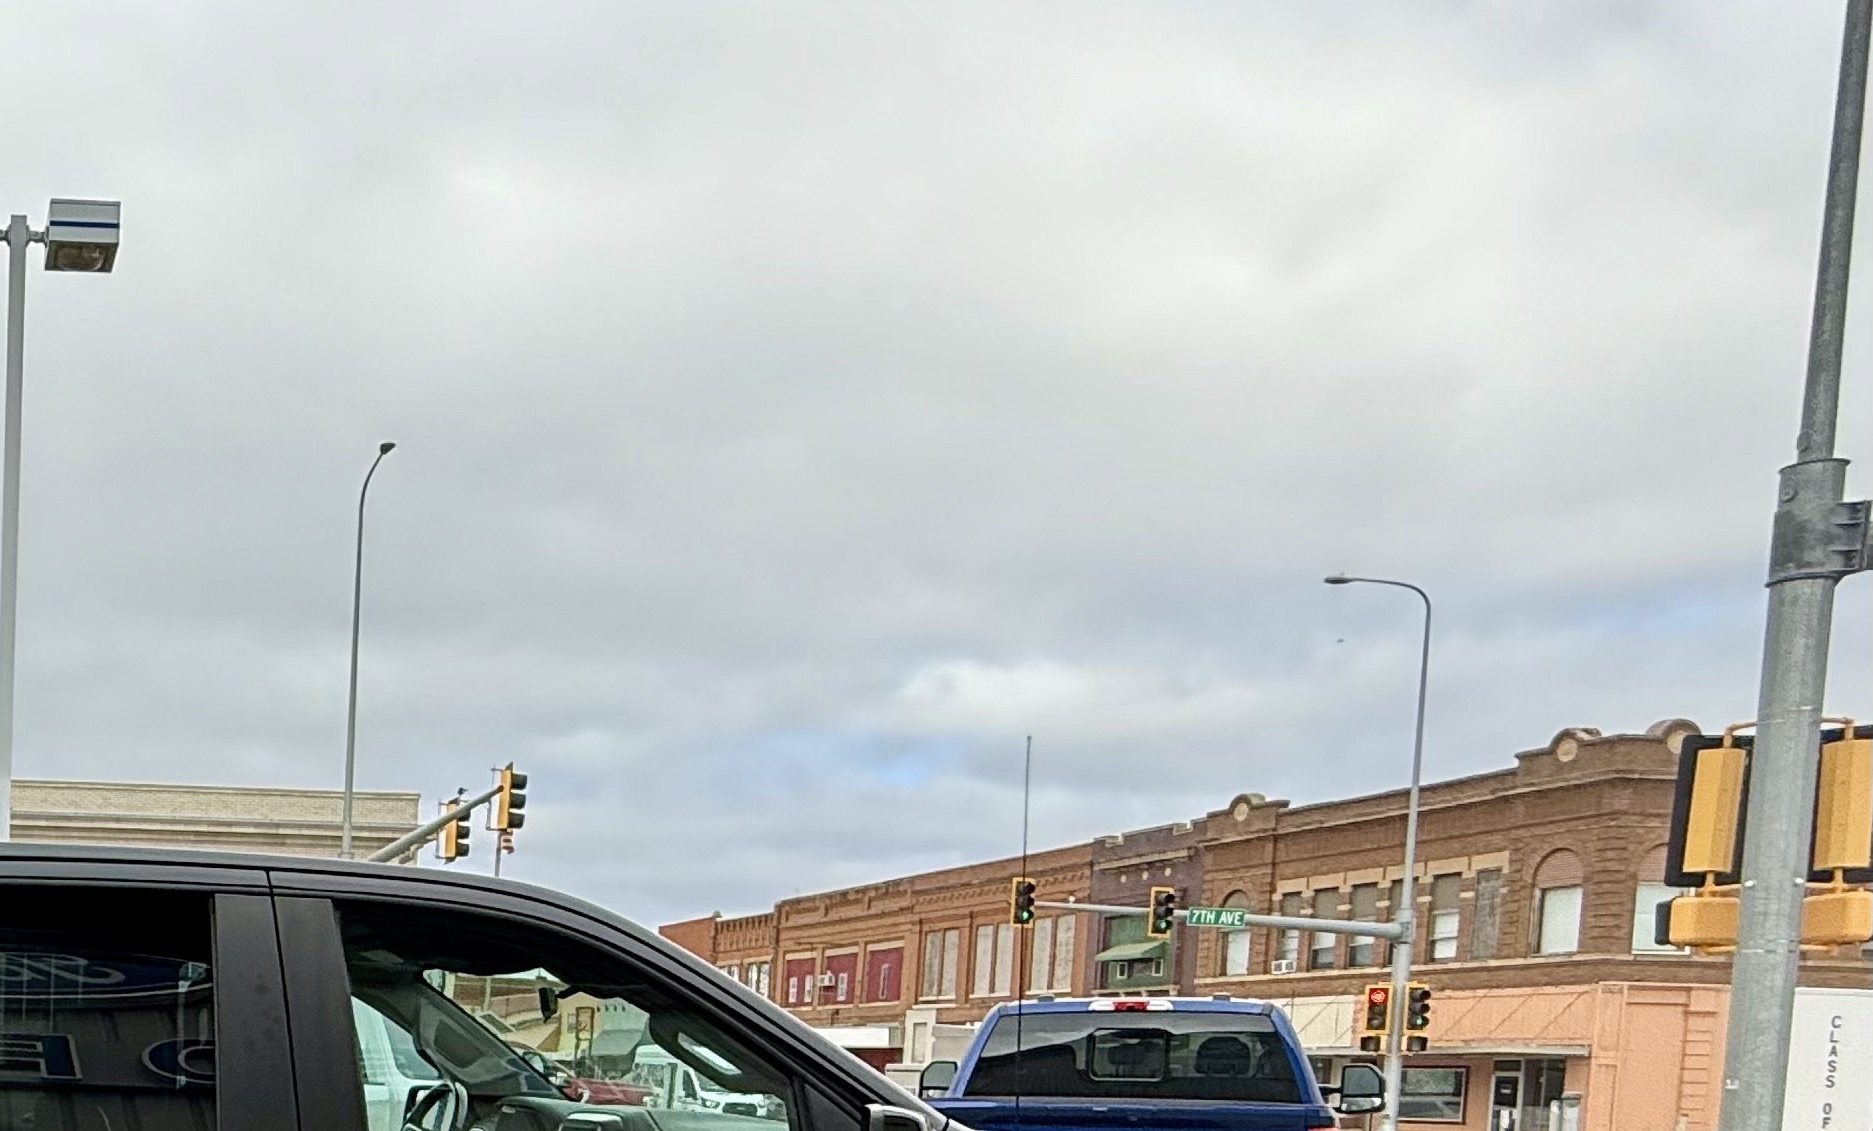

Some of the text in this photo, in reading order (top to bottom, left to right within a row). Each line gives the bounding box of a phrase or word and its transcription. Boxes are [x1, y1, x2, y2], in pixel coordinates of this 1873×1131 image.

[1192, 910, 1244, 925] 7TH AVE
[1821, 1015, 1842, 1129] CLASS OF
